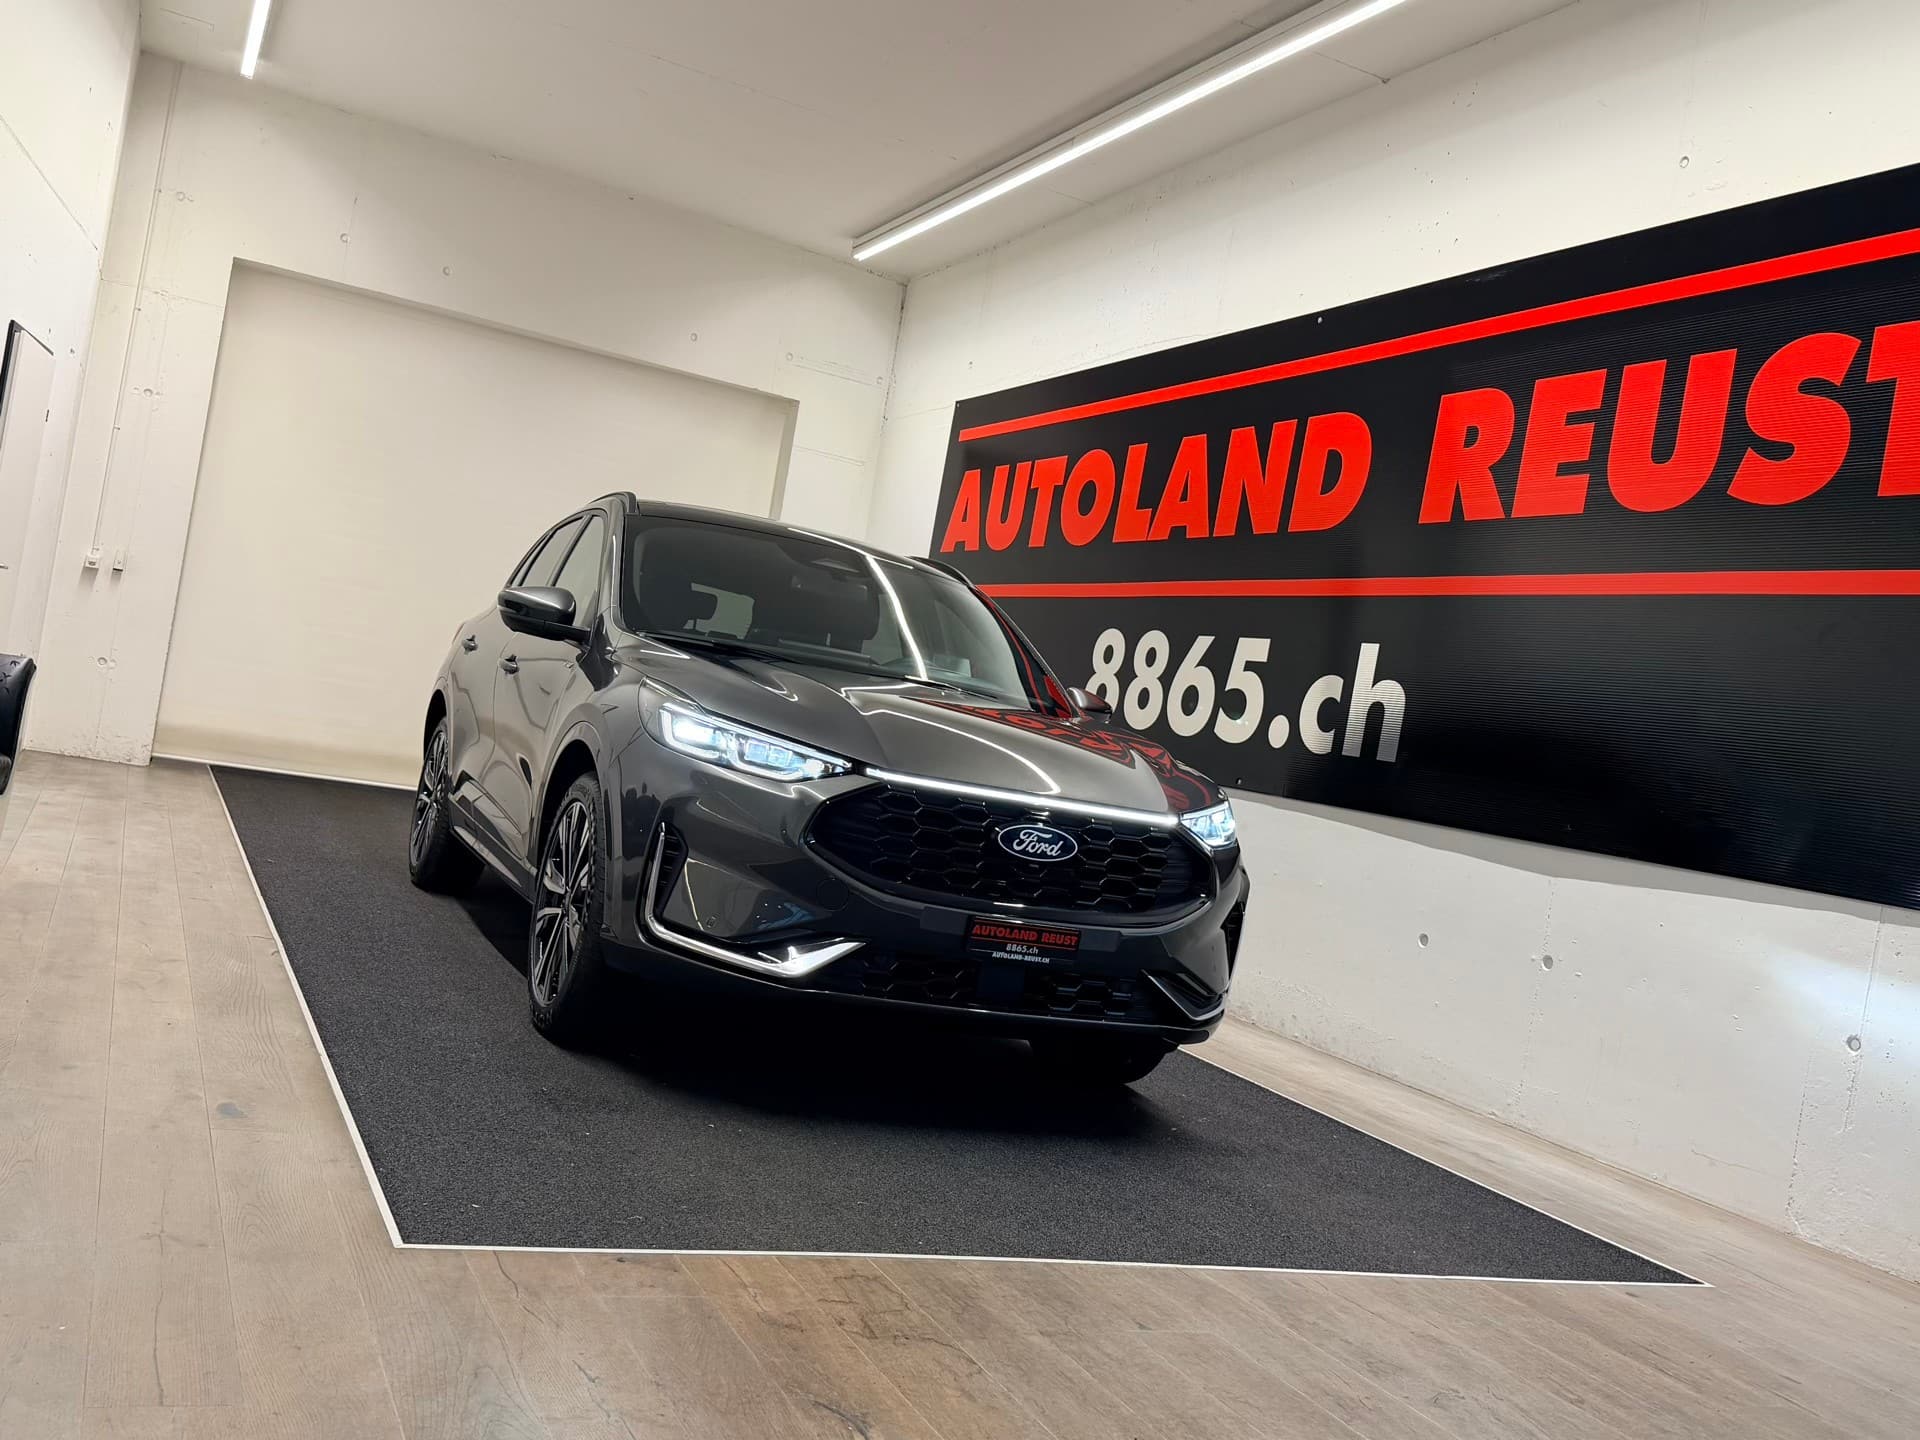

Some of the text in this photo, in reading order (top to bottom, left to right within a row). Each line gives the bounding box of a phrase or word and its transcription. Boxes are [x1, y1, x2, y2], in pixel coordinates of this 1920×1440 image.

[940, 411, 1372, 553] AUTOLAND
[1085, 628, 1406, 763] 8865.ch
[1013, 829, 1064, 856] Ford
[972, 925, 1077, 945] AUTOLAND REUST
[1006, 943, 1038, 954] 8865.ch
